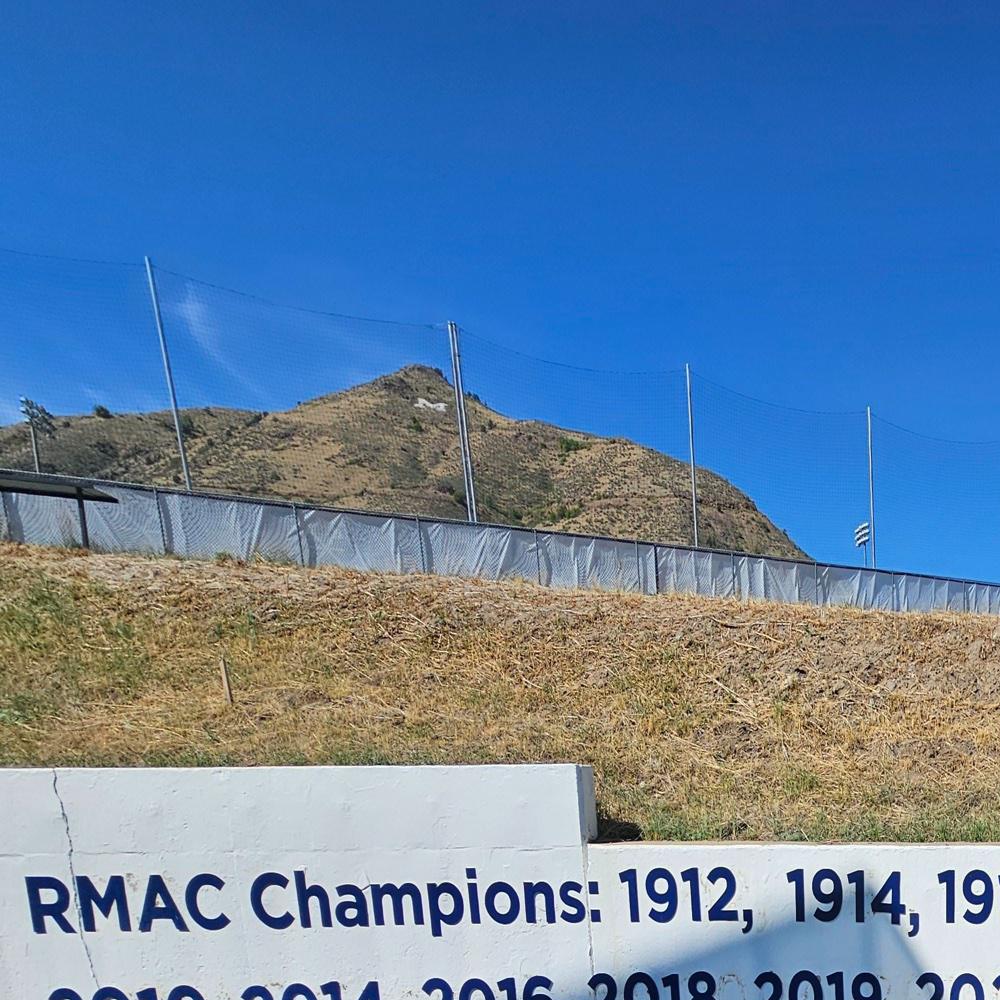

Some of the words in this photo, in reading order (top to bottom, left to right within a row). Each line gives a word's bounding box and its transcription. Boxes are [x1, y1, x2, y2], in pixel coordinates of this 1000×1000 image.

[25, 873, 231, 935] RMAC
[250, 867, 601, 938] Champions:
[618, 866, 754, 935] 1912,
[786, 868, 920, 938] 1914,
